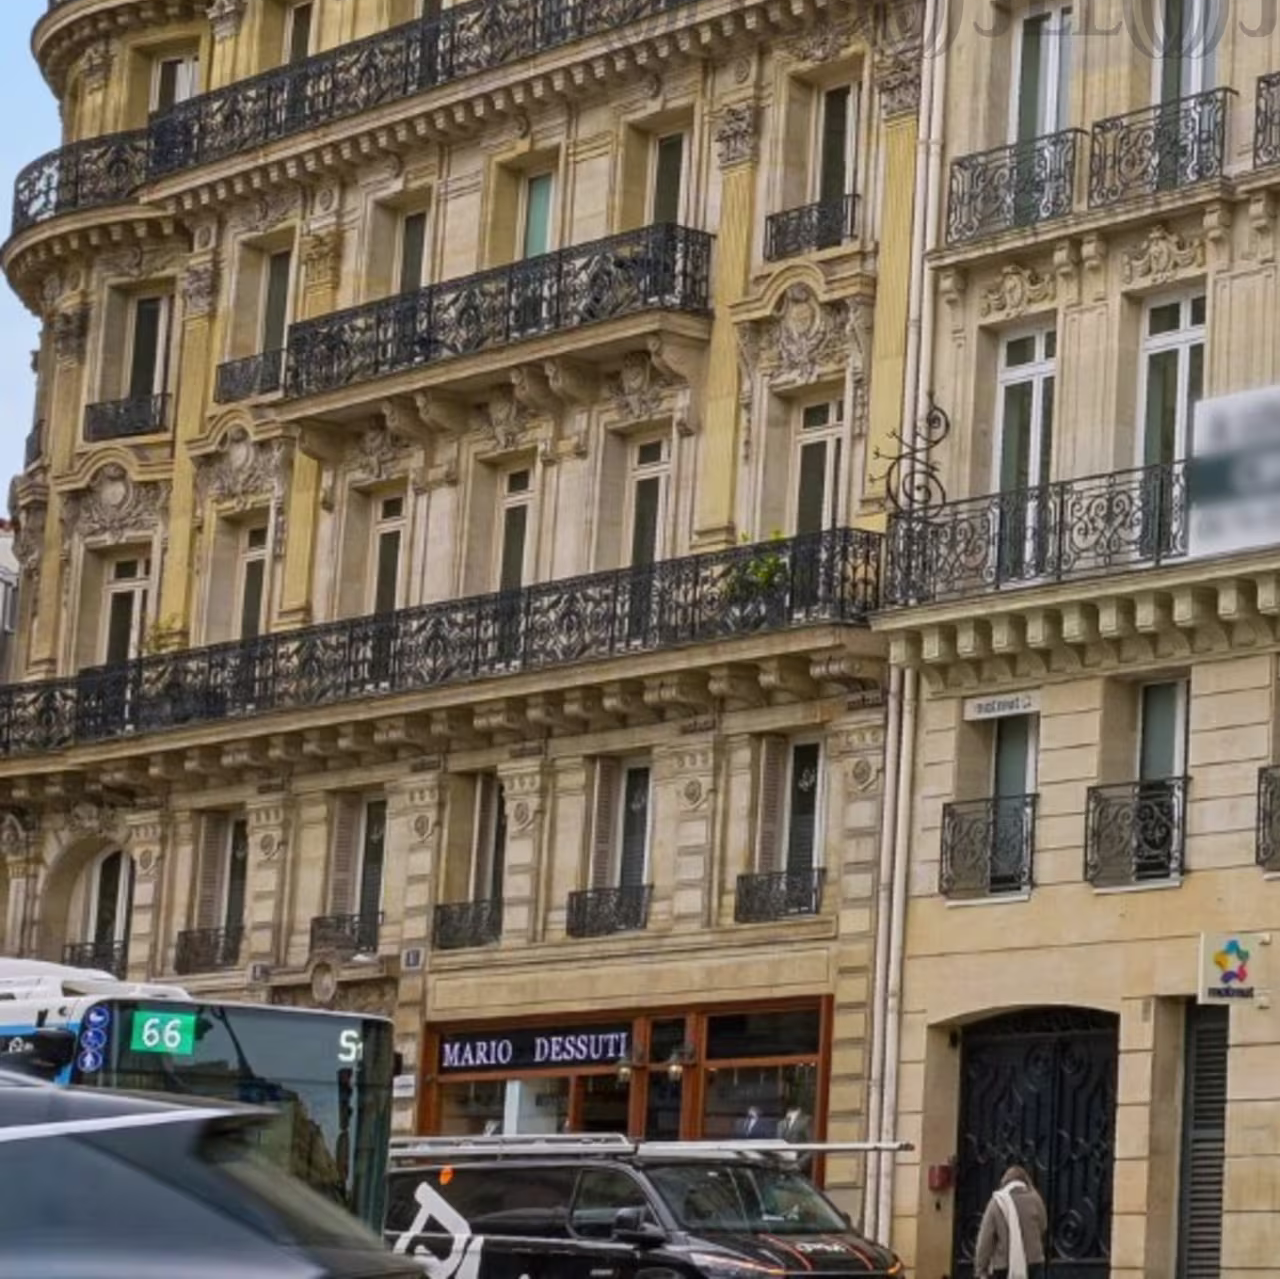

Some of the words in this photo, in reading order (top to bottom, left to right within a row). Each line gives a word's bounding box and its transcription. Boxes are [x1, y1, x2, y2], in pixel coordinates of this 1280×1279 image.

[143, 1017, 182, 1048] 66
[442, 1039, 513, 1067] MARIO
[534, 1032, 628, 1062] DESSUTI
